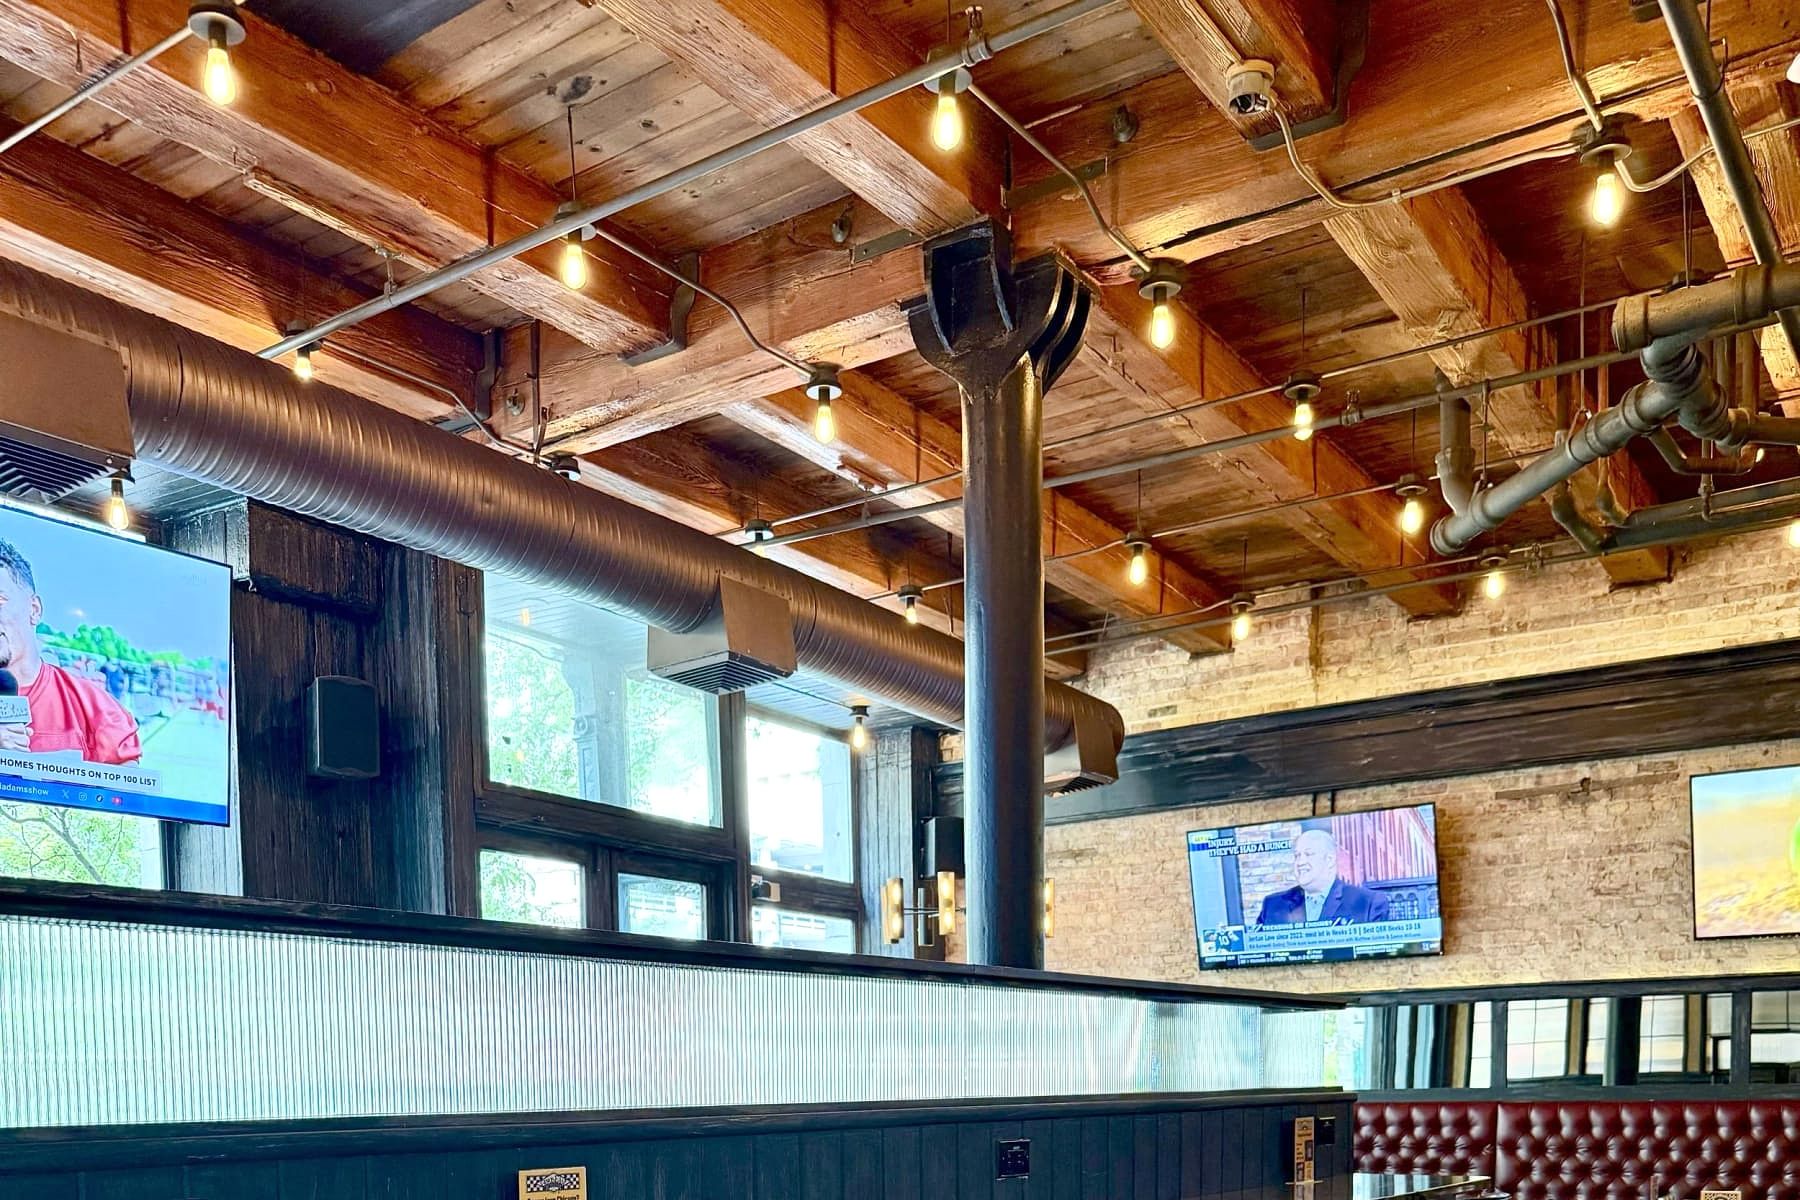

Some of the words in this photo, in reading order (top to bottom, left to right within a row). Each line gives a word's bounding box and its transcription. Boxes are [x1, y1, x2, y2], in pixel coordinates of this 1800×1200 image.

[0, 758, 34, 770] HOMES
[36, 762, 86, 777] THOUGHTS
[88, 770, 101, 779] ON
[104, 772, 121, 781] TOP
[123, 775, 138, 784] 100
[140, 776, 157, 787] LIST
[1240, 844, 1257, 854] HAD
